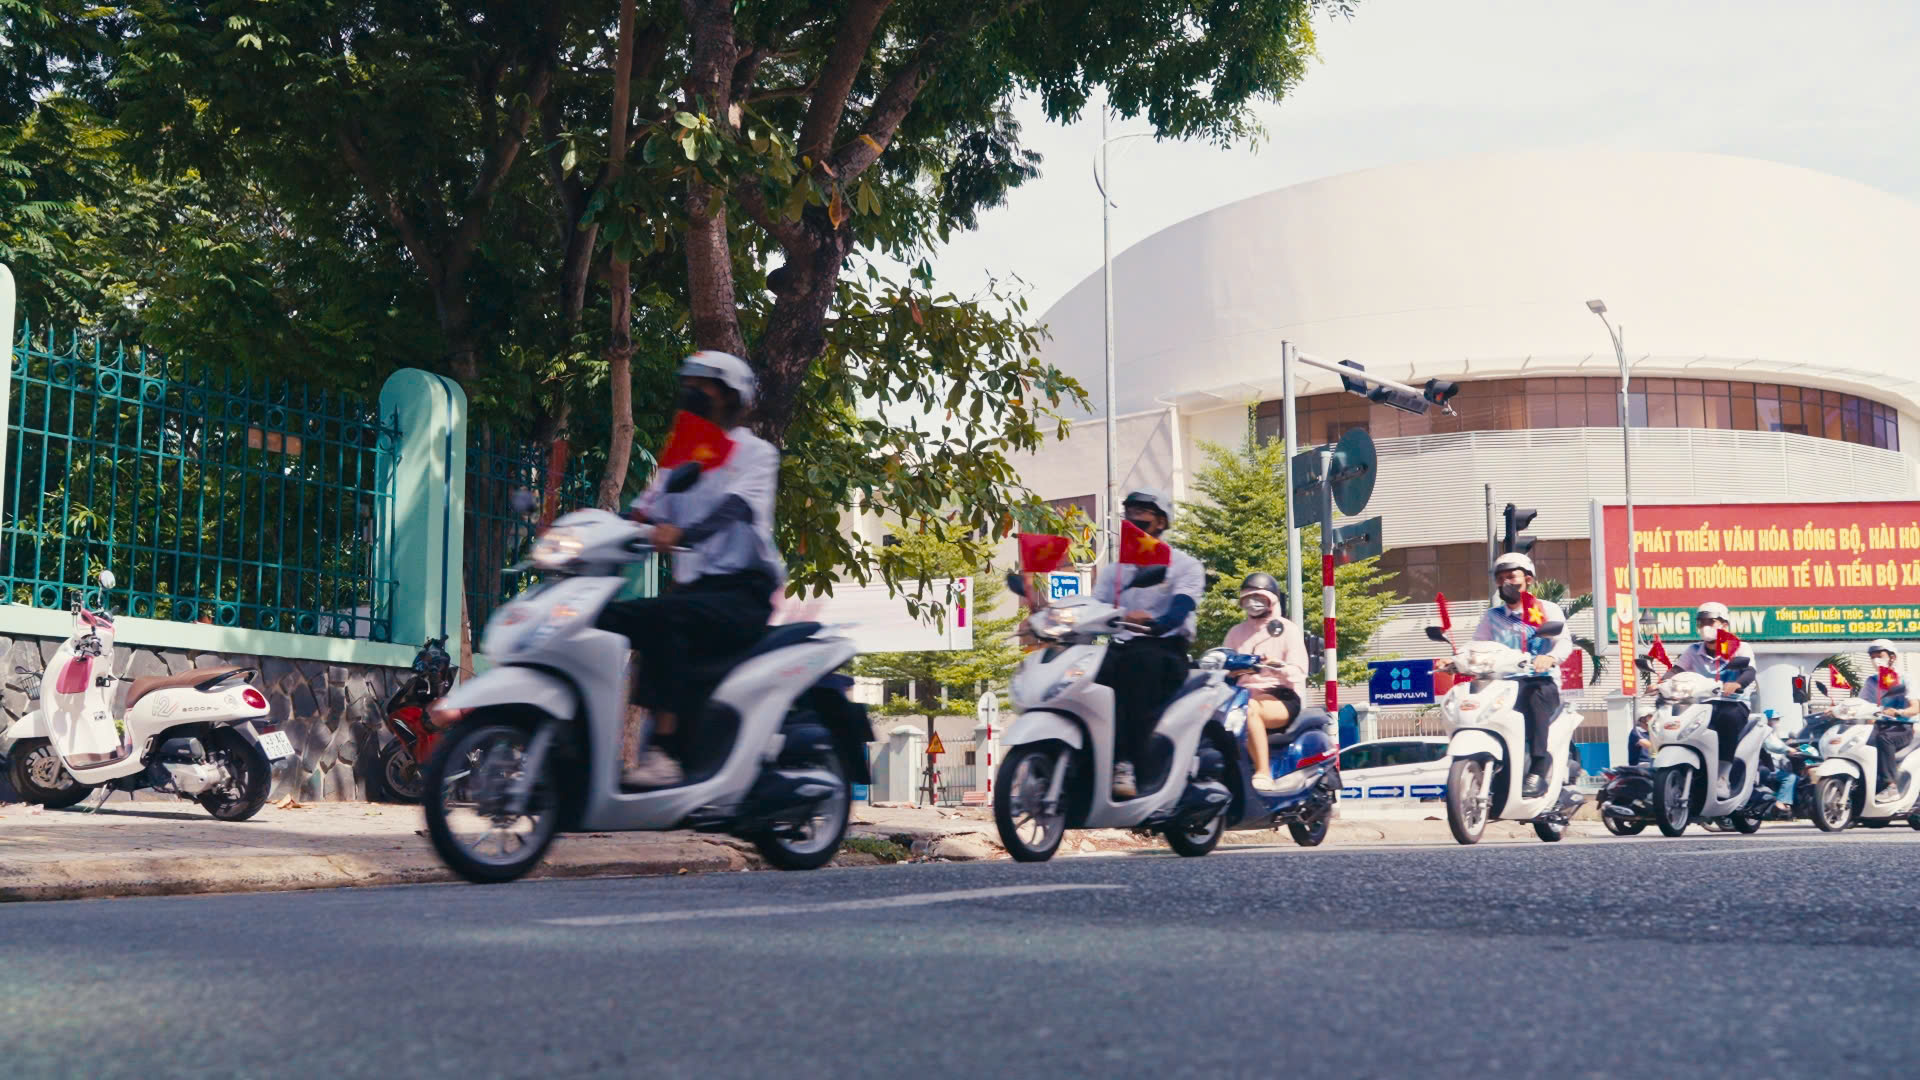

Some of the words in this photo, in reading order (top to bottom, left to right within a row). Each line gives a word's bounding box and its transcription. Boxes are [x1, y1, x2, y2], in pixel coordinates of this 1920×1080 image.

[1634, 526, 1672, 552] PHÁT
[1675, 521, 1720, 552] TRIỂN
[1723, 525, 1755, 552] VĂN
[1758, 524, 1790, 551] HÓA
[1839, 523, 1866, 555] BỘ,
[1868, 522, 1896, 549] HÀI
[1642, 562, 1683, 589] TĂNG
[1686, 559, 1748, 589] TRƯỞNG
[1751, 566, 1789, 588] KINH
[1792, 558, 1811, 588] TẾ
[1813, 560, 1835, 587] VÀ
[1837, 557, 1873, 587] TIẾN
[1876, 559, 1898, 591] BỘ
[1792, 622, 1845, 634] Hotline:
